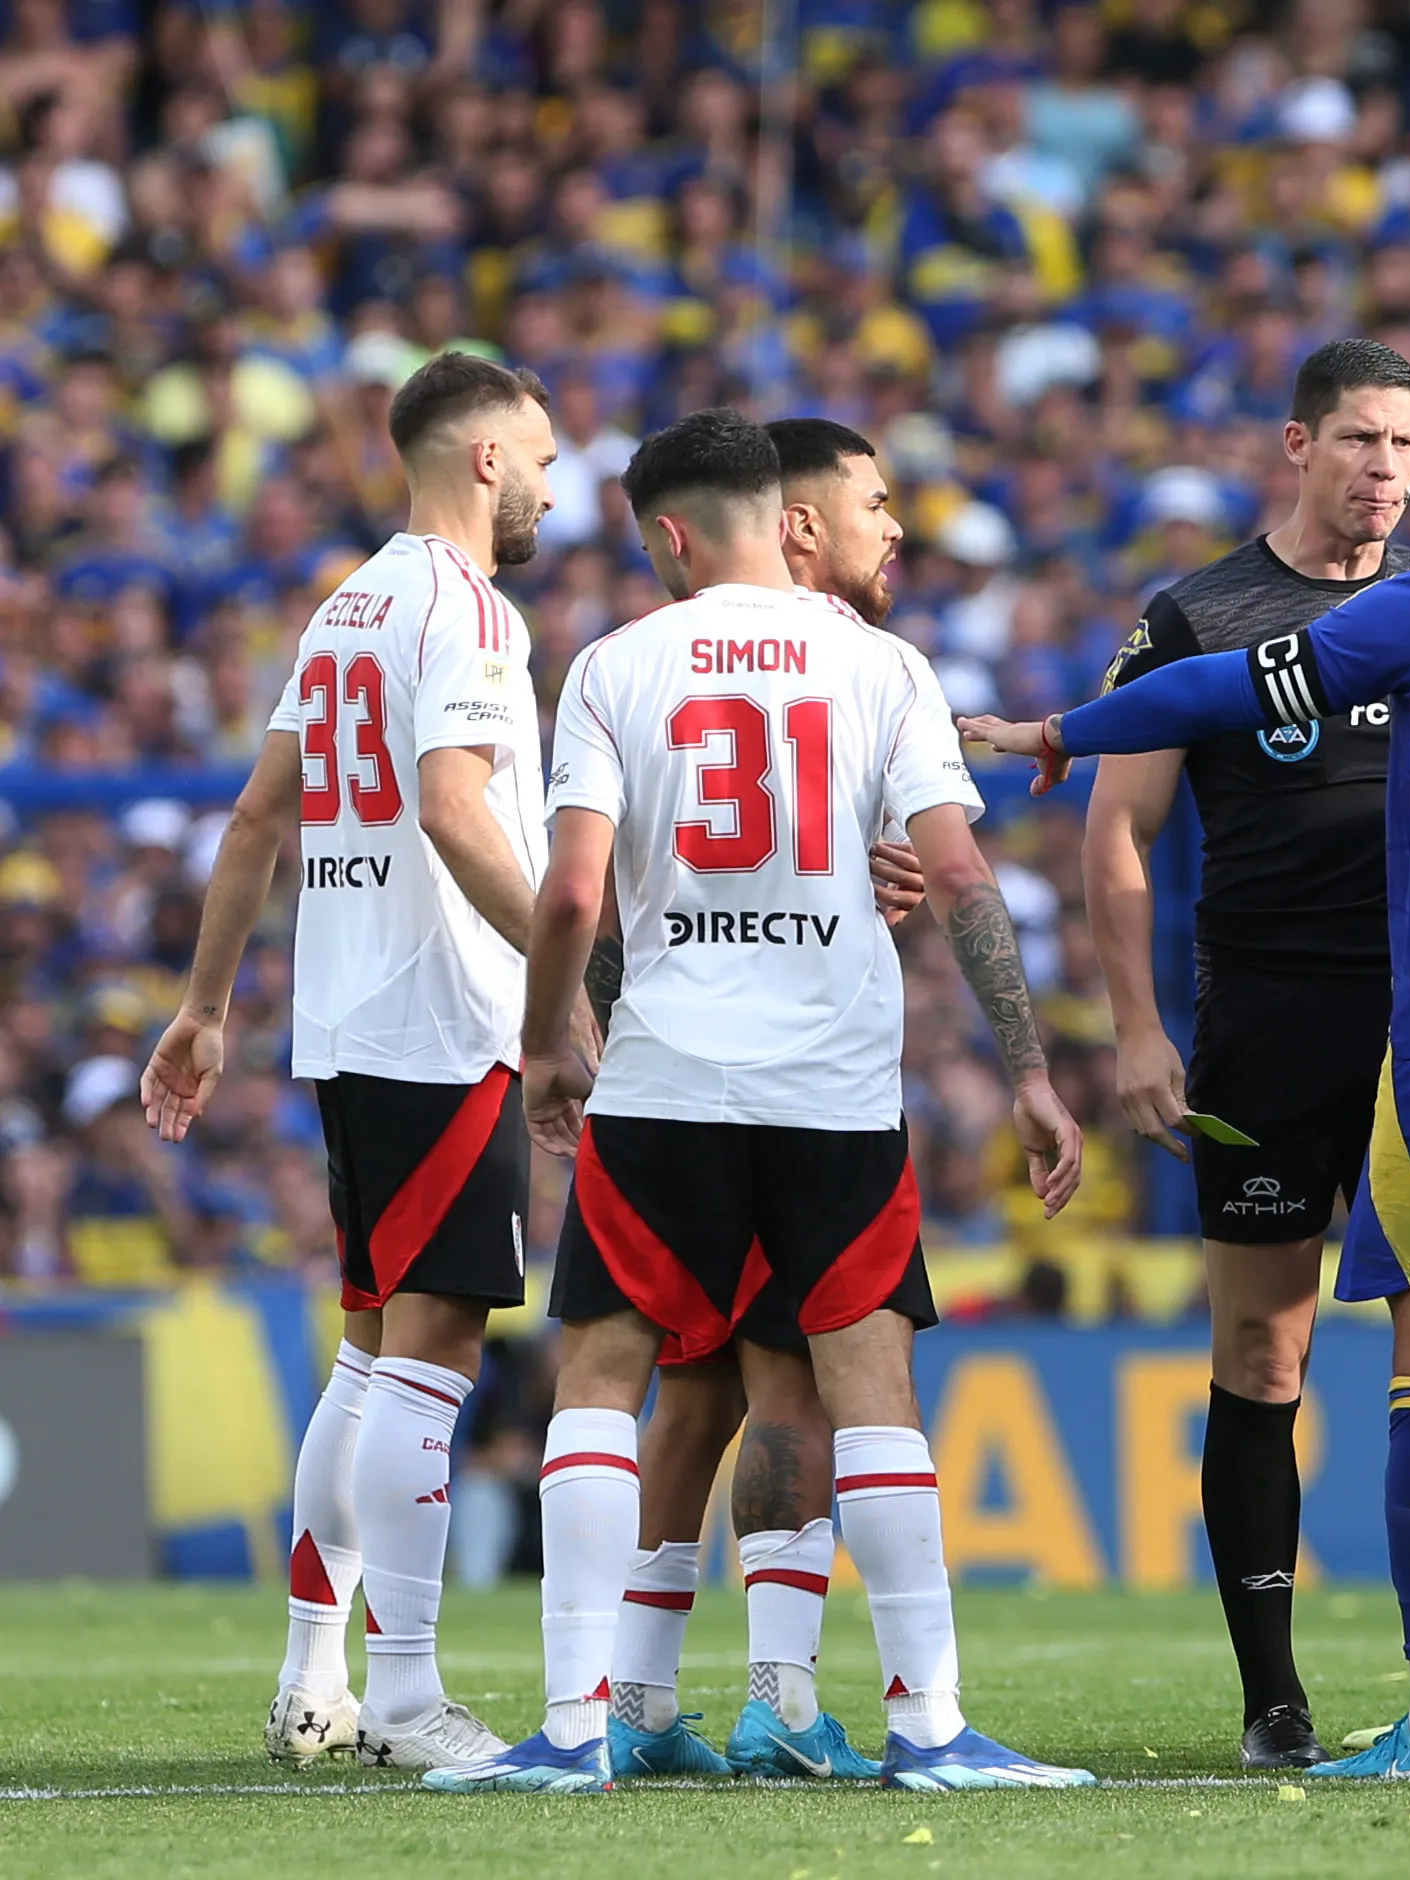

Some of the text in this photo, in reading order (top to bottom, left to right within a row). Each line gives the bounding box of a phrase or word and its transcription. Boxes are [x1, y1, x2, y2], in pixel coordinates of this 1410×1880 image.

[691, 638, 807, 675] SIMON
[299, 651, 405, 828] 33
[665, 693, 834, 876] 31
[664, 911, 840, 947] DIRECTV
[1222, 1198, 1306, 1215] ATHIX
